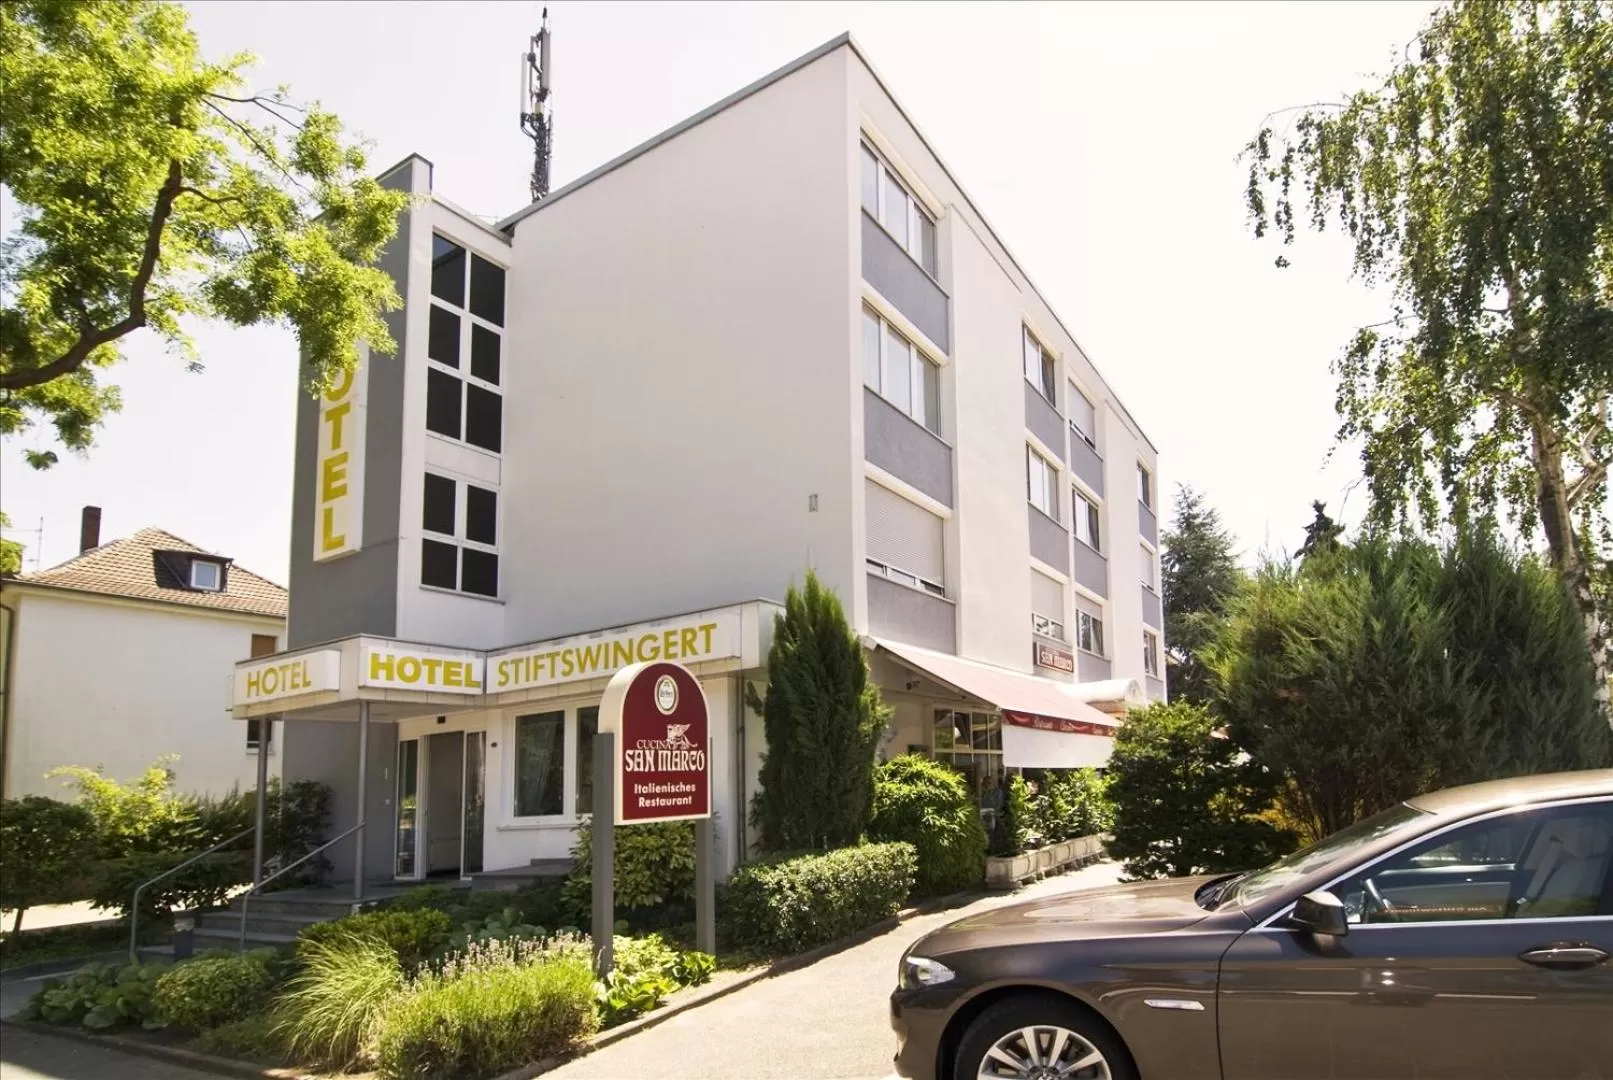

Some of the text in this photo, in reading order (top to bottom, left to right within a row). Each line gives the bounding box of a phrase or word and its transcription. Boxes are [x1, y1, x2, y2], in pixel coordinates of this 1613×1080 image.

[322, 362, 356, 553] OTEL
[369, 653, 482, 689] HOTEL
[497, 623, 718, 688] STIFTSWINGERT
[247, 660, 312, 698] HOTEL
[625, 749, 705, 772] SAN MARCO
[634, 782, 696, 795] Italienisches
[638, 796, 692, 809] Restaurant
